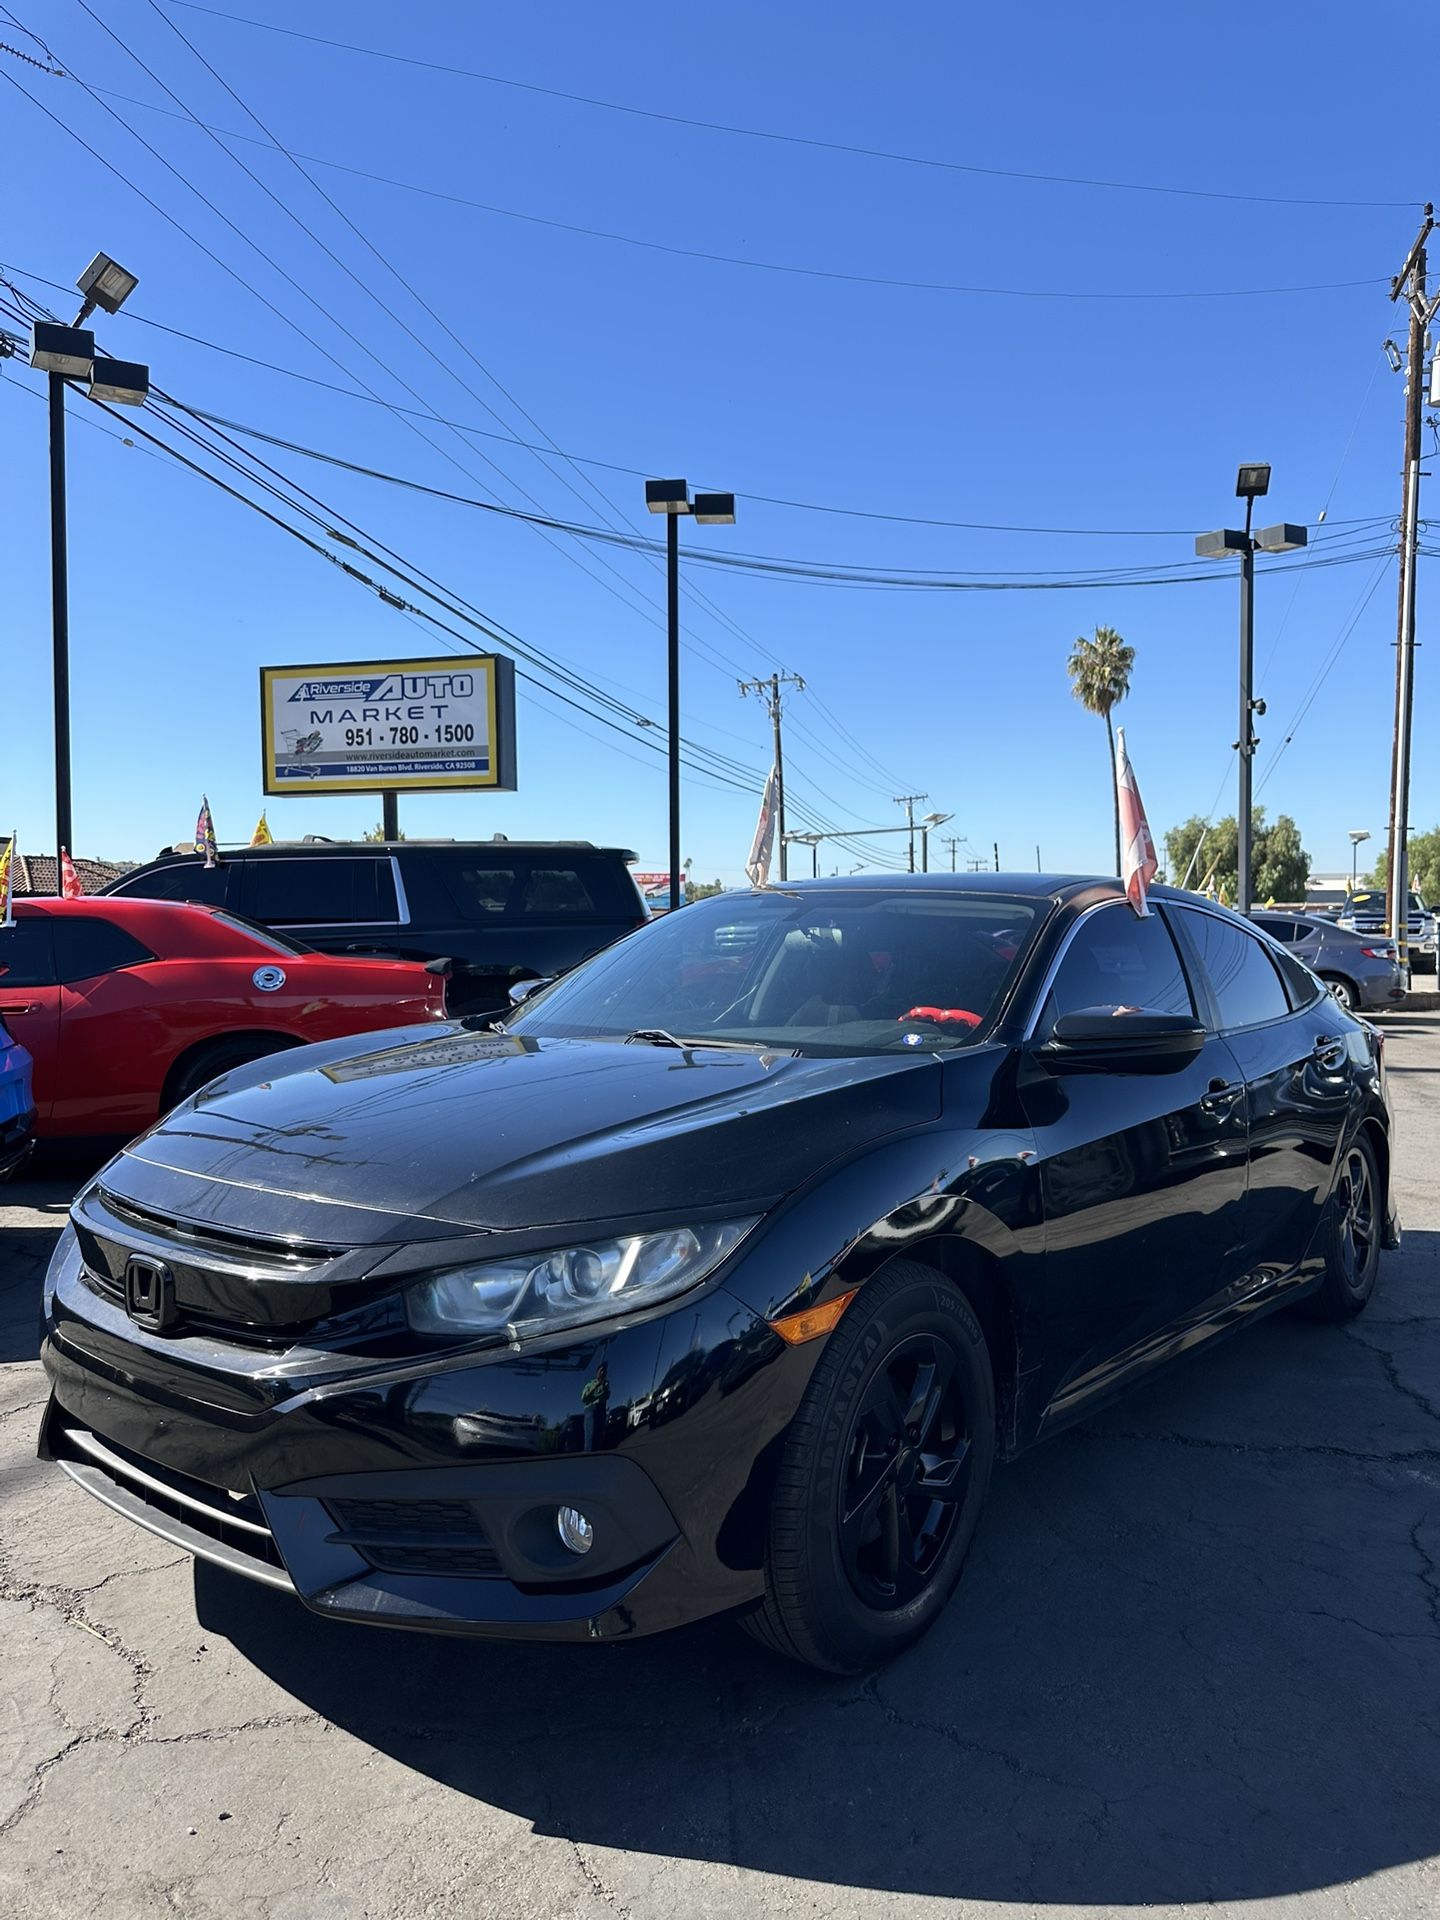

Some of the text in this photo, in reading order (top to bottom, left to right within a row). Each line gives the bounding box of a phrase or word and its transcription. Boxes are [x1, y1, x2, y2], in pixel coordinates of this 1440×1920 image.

[310, 682, 371, 694] Riverside
[364, 674, 474, 702] AUTO
[310, 705, 449, 724] MARKET
[345, 750, 475, 761] www.riversideautomarket.com
[379, 764, 397, 772] Buren
[445, 761, 456, 769] CA
